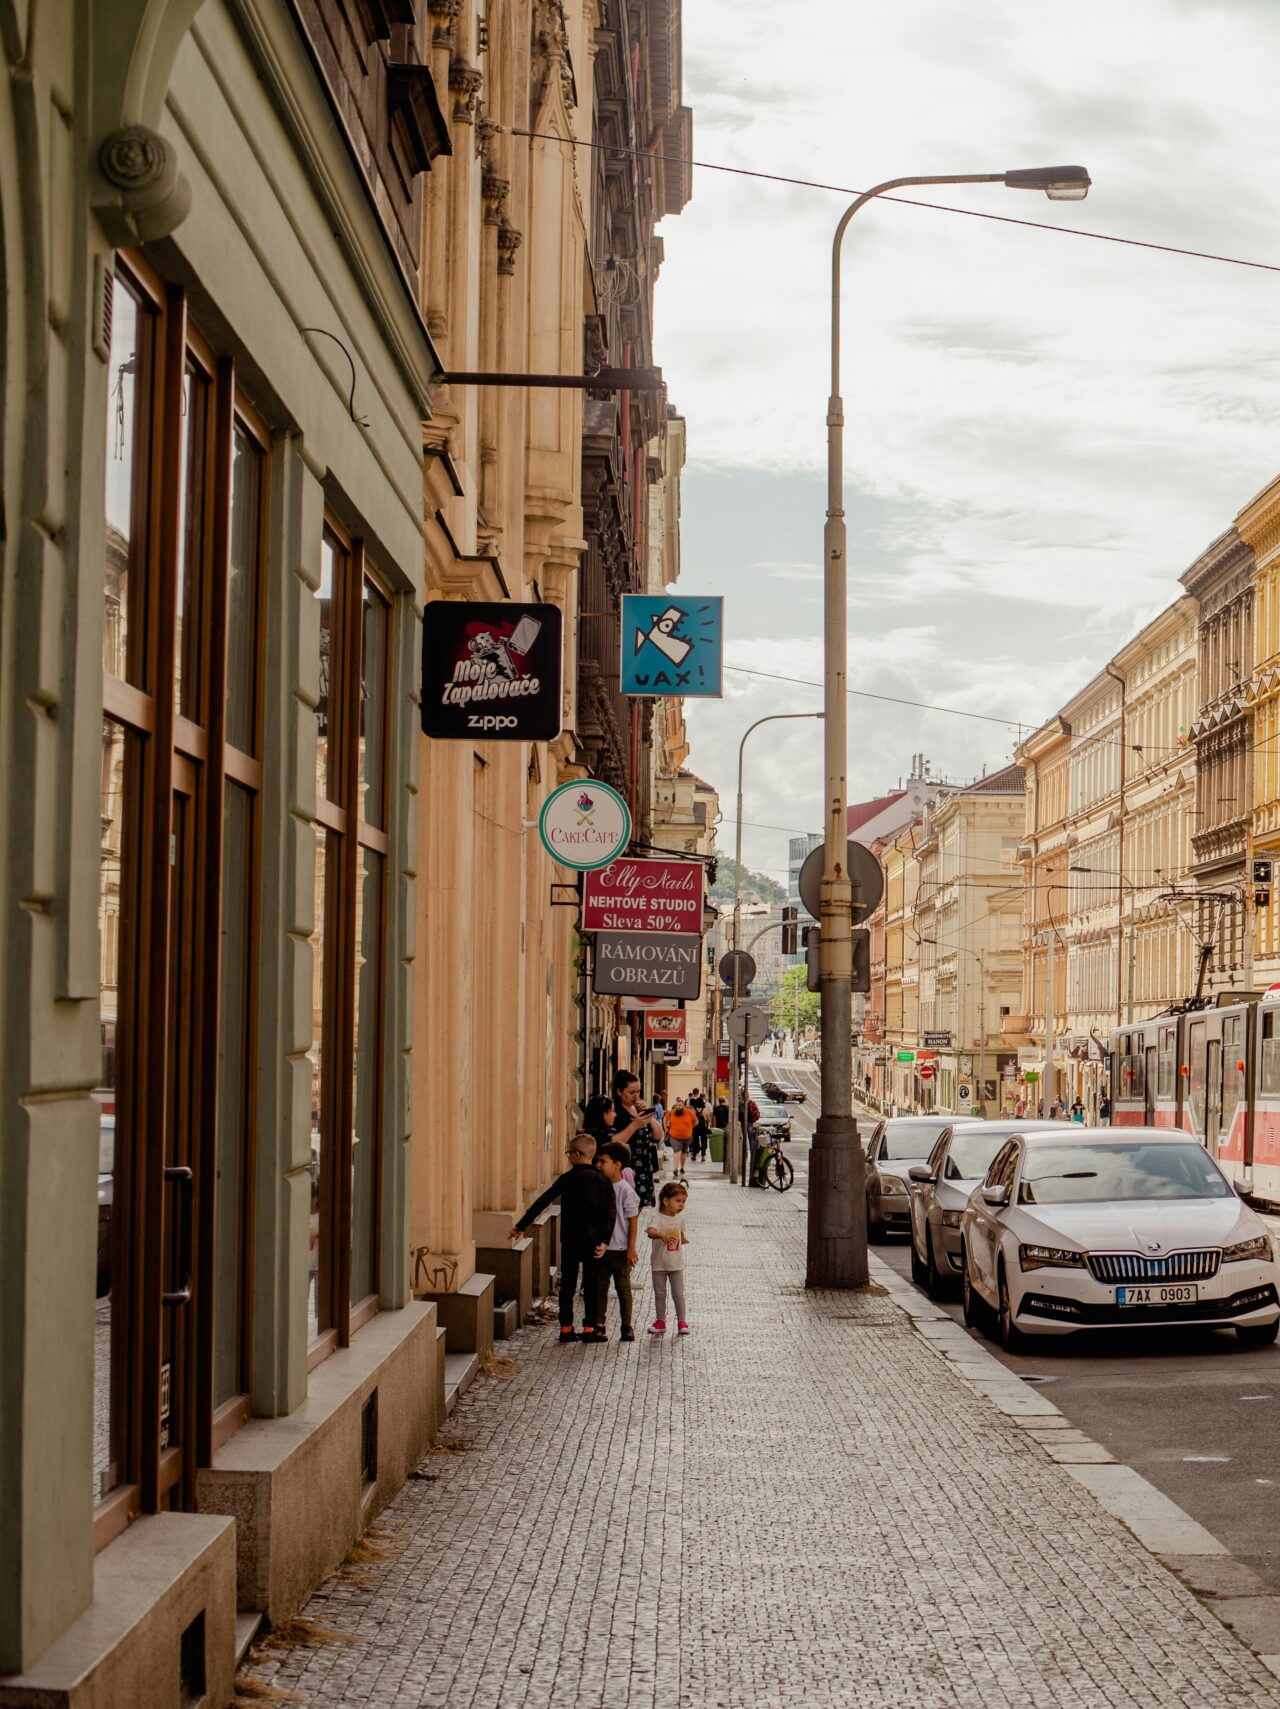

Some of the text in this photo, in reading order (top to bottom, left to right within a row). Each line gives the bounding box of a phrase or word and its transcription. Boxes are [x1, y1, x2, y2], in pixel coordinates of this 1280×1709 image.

[453, 659, 497, 684] Moje
[442, 673, 540, 707] Zapalovače
[600, 864, 695, 896] Elly Nails
[589, 895, 697, 912] NEHTOVÉ STUDIO
[603, 913, 681, 931] Sleva 50%
[600, 940, 697, 964] RÁMOVÁNÍ
[611, 965, 685, 985] OBRAZŮ
[1128, 1287, 1191, 1303] 7AX 0903
